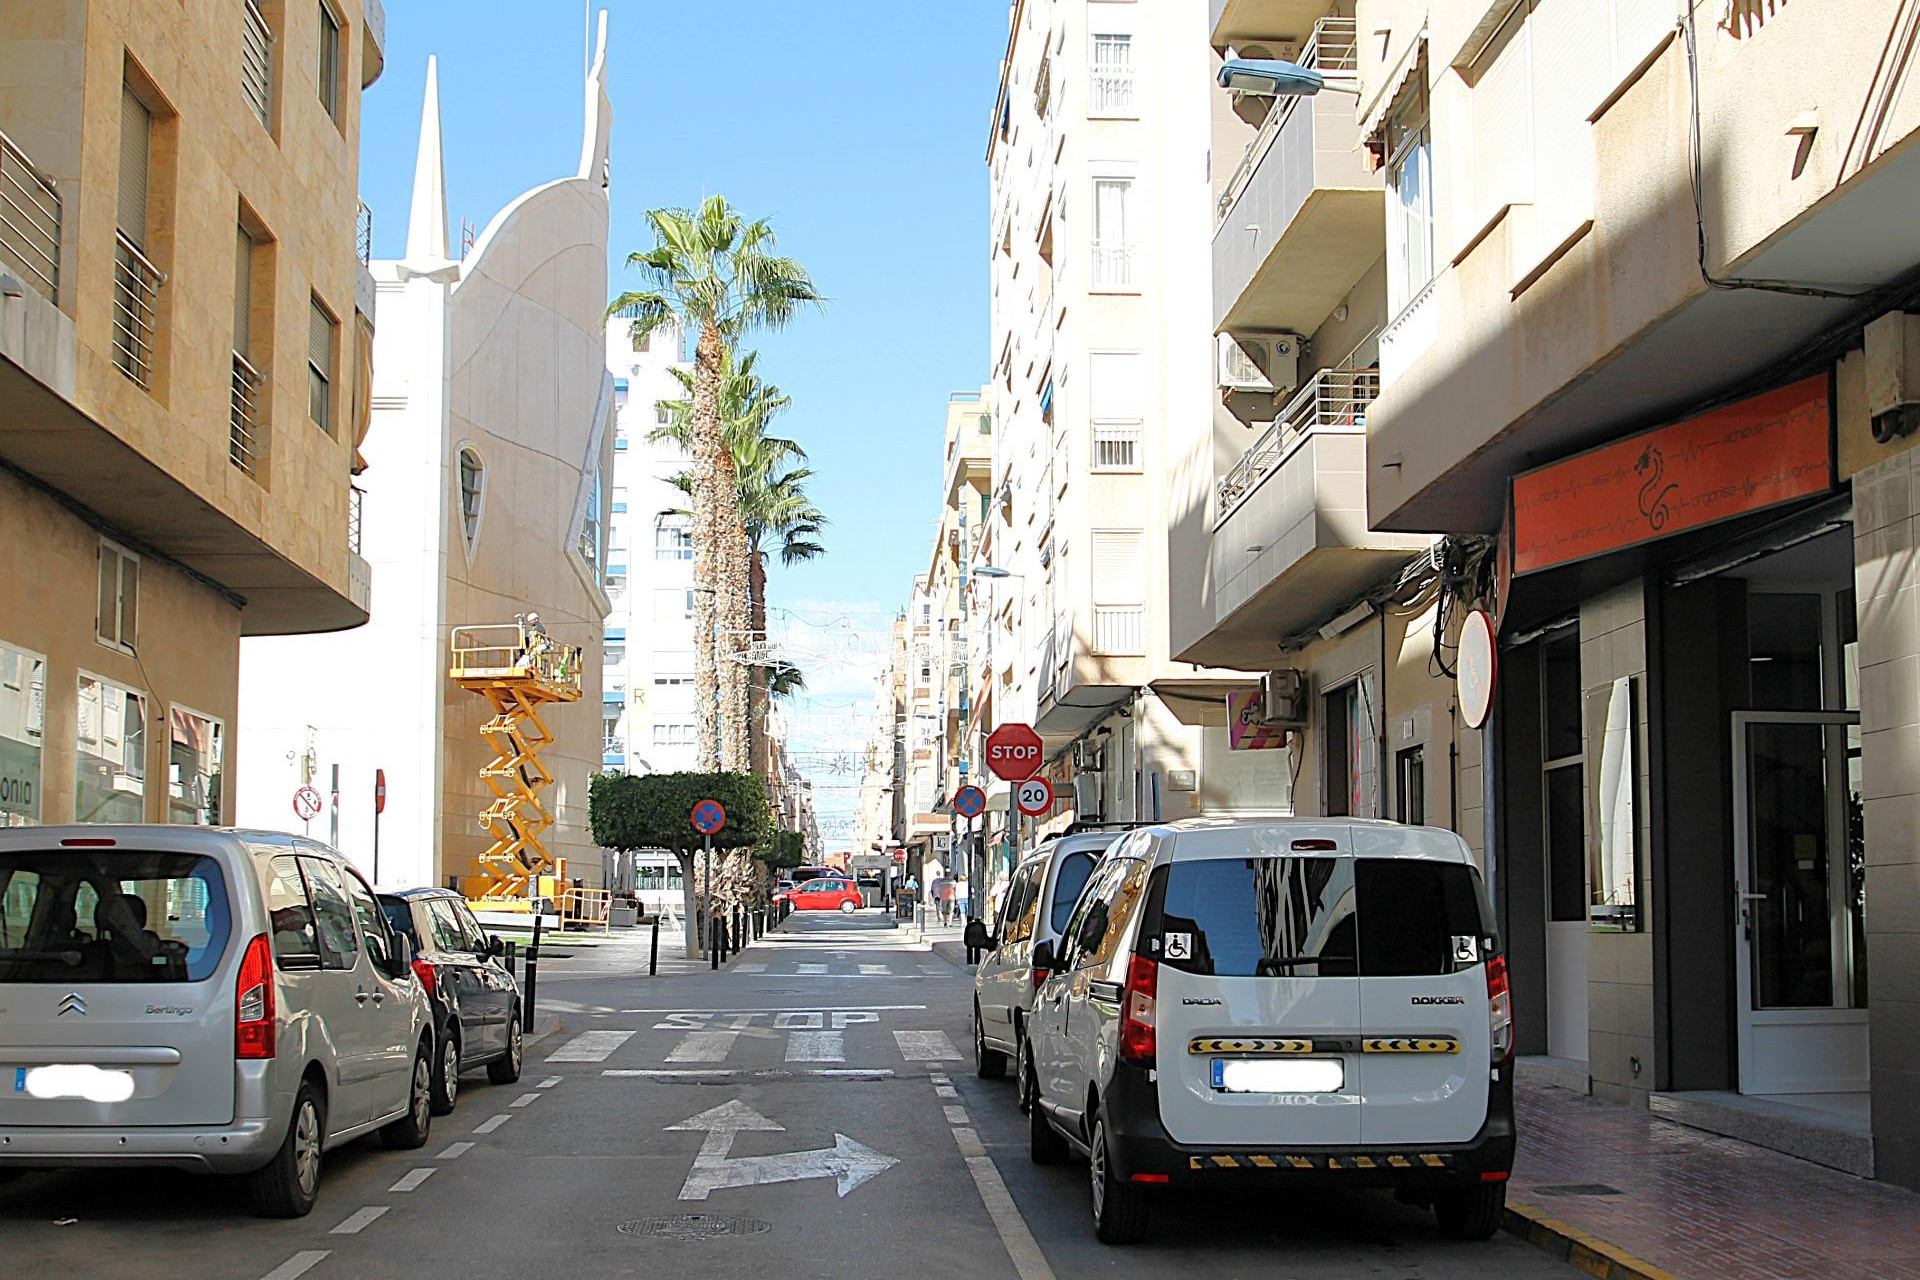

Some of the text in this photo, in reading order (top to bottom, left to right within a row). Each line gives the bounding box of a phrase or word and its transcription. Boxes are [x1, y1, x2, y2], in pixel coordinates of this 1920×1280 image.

[991, 745, 1038, 760] STOP
[1022, 789, 1045, 803] 20
[1182, 997, 1222, 1006] DACIA
[1411, 996, 1465, 1005] DOKKER
[145, 1004, 193, 1016] Berlingo
[652, 1011, 880, 1029] STOP
